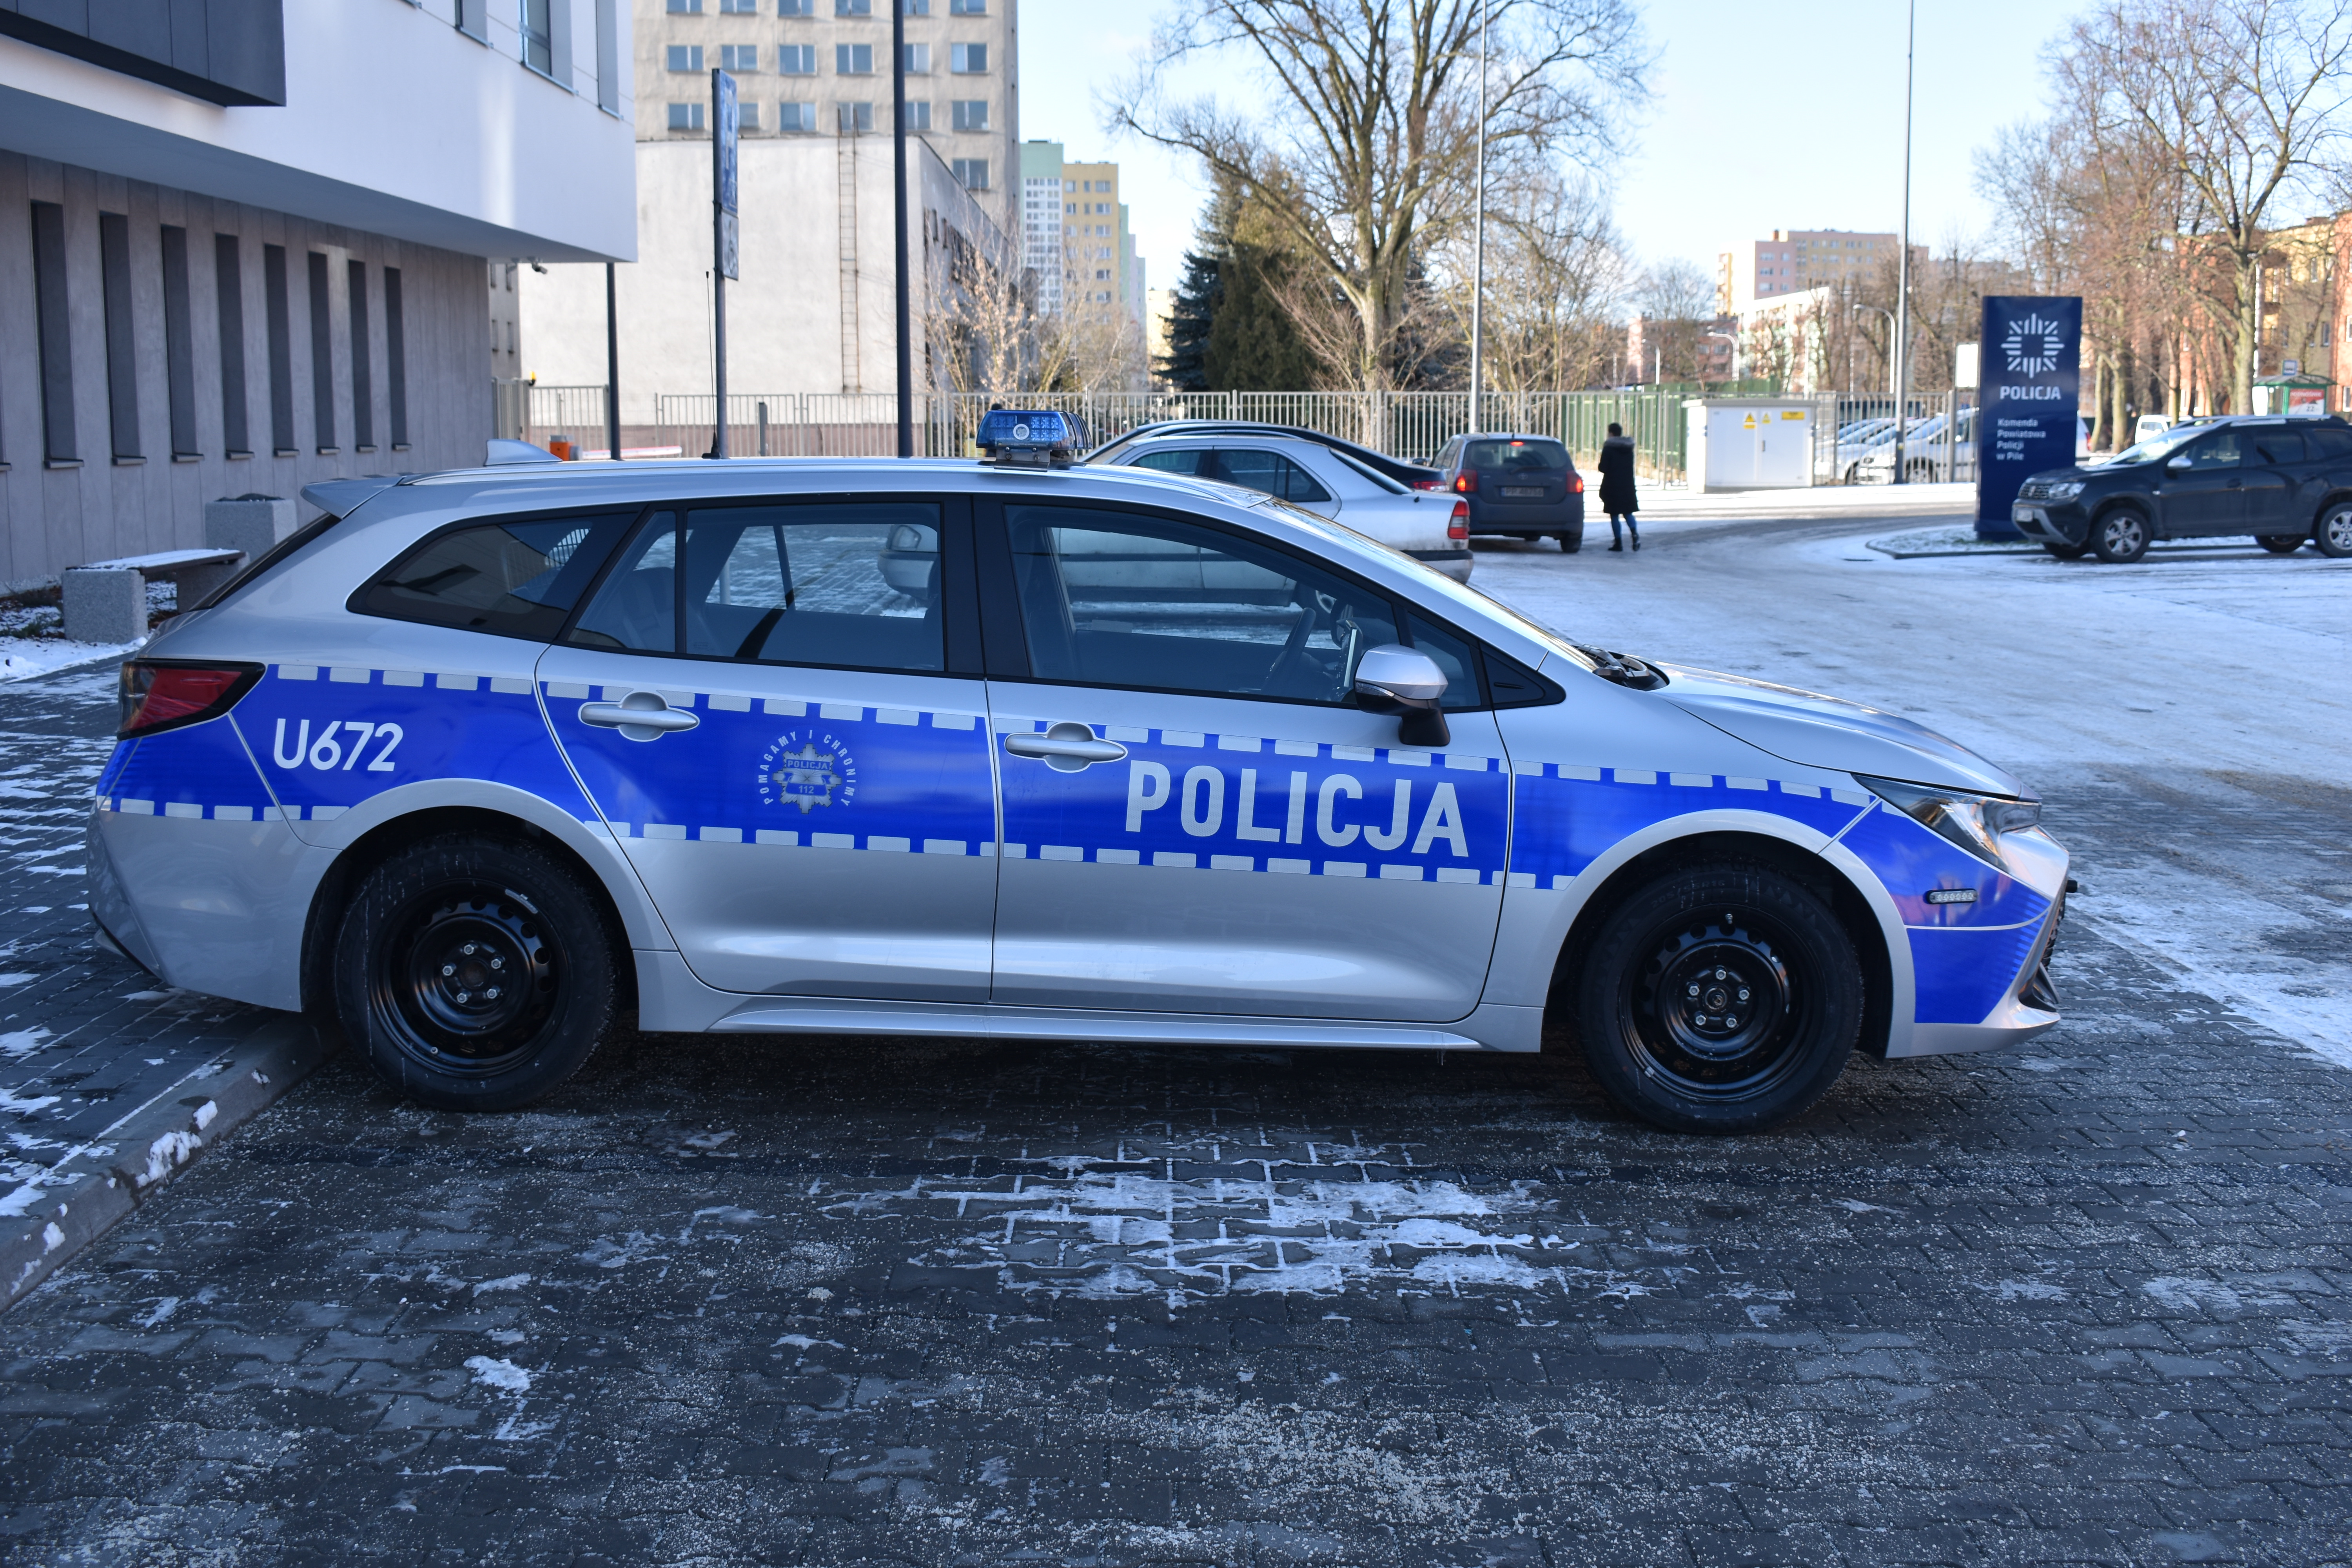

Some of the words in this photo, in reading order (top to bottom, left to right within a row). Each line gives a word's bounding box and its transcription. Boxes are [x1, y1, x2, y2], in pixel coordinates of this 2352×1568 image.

[2000, 385, 2062, 400] POLICJA
[1997, 418, 2038, 427] Komenda
[1997, 429, 2046, 438] Powiatowa
[1996, 440, 2024, 451] Policji
[2007, 452, 2024, 461] Pile
[274, 718, 403, 771] U672
[758, 731, 796, 805] POMAGAMY
[809, 729, 813, 739] I
[824, 734, 856, 806] CHRONIMY
[788, 760, 828, 770] POLICJA
[799, 785, 814, 794] 112
[1125, 760, 1469, 857] POLICJA
